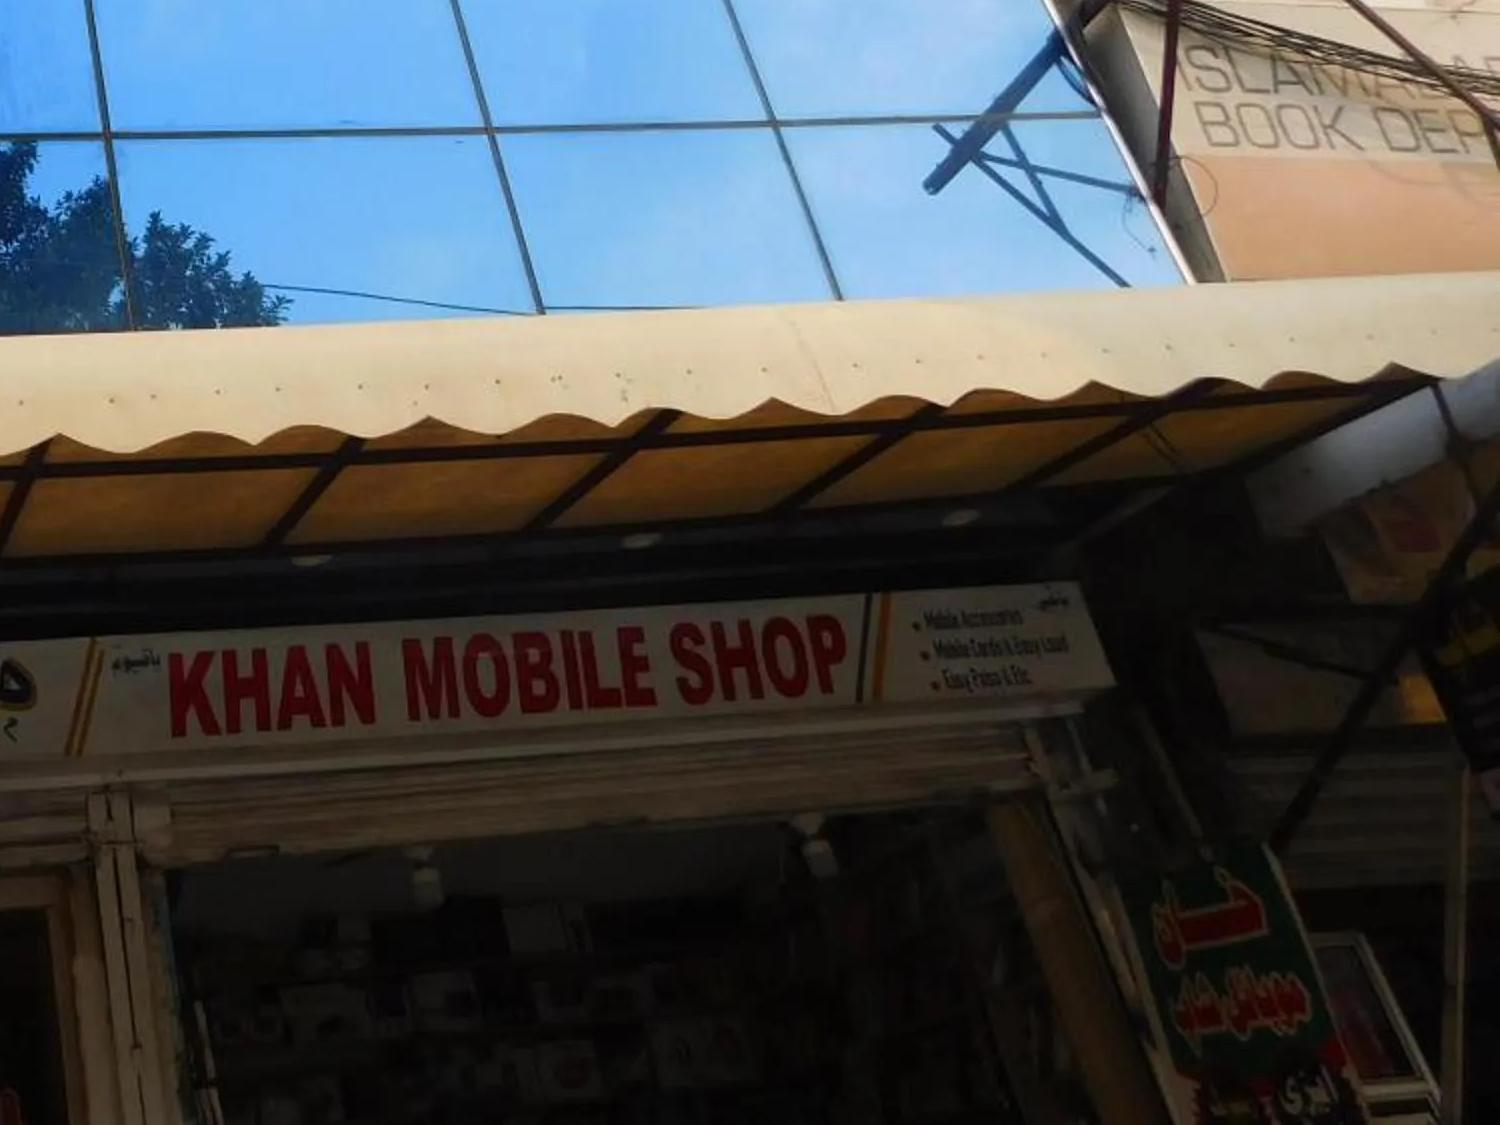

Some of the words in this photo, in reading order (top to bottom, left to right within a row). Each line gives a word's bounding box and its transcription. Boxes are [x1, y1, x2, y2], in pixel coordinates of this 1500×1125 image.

[1194, 101, 1365, 153] BOOK
[168, 642, 376, 738] KHAN
[402, 626, 658, 721] MOBILE
[670, 614, 847, 706] SHOP
